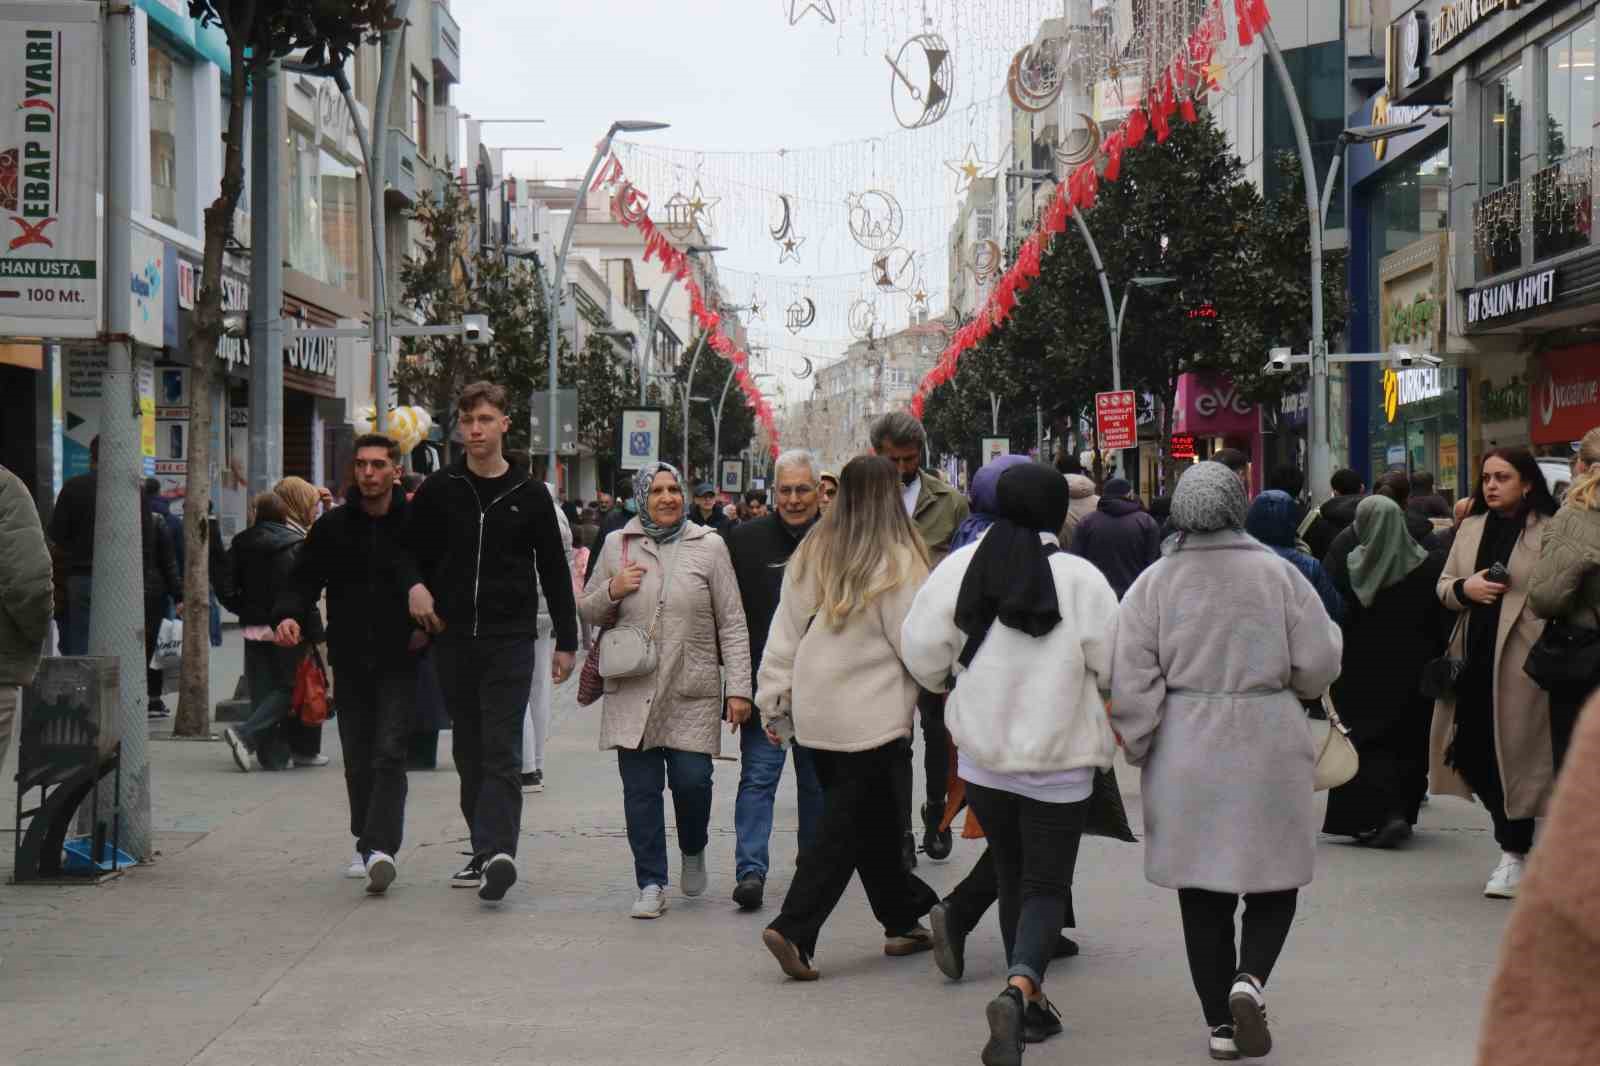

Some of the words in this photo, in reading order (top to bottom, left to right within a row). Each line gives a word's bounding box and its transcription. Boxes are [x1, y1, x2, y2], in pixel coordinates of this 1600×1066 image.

[1, 261, 36, 274] HAN
[40, 262, 81, 276] USTA
[27, 288, 55, 302] 100
[59, 289, 86, 303] Mt.
[1468, 293, 1482, 323] BY
[1482, 284, 1514, 320] SALON
[1515, 270, 1556, 311] AHMET
[1397, 368, 1441, 405] TURKCELL
